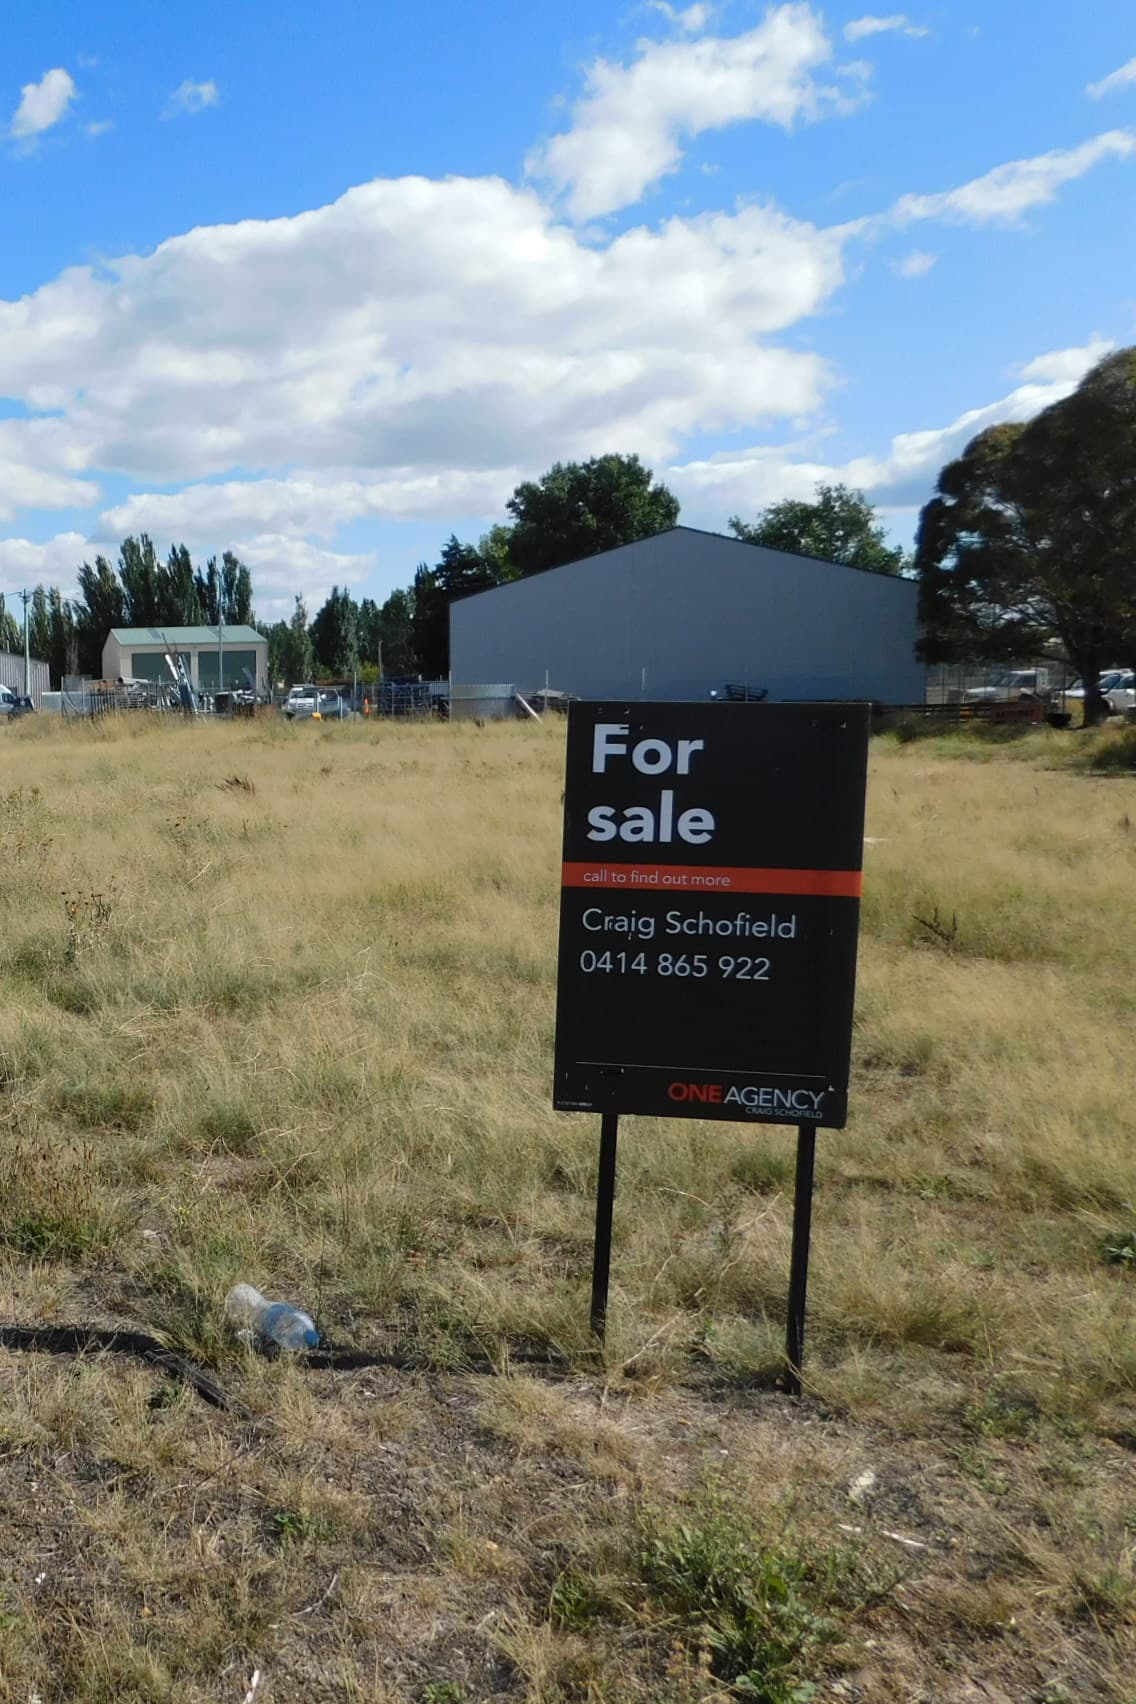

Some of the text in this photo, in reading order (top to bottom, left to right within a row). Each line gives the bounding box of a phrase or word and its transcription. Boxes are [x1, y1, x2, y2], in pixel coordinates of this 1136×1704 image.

[592, 723, 704, 775] For
[586, 789, 715, 845] sale
[583, 869, 731, 887] call to find out more
[582, 908, 796, 940] Craig Schofield
[580, 949, 771, 981] 0414 865 922
[745, 1106, 823, 1119] CRAIG SCHOFIELD
